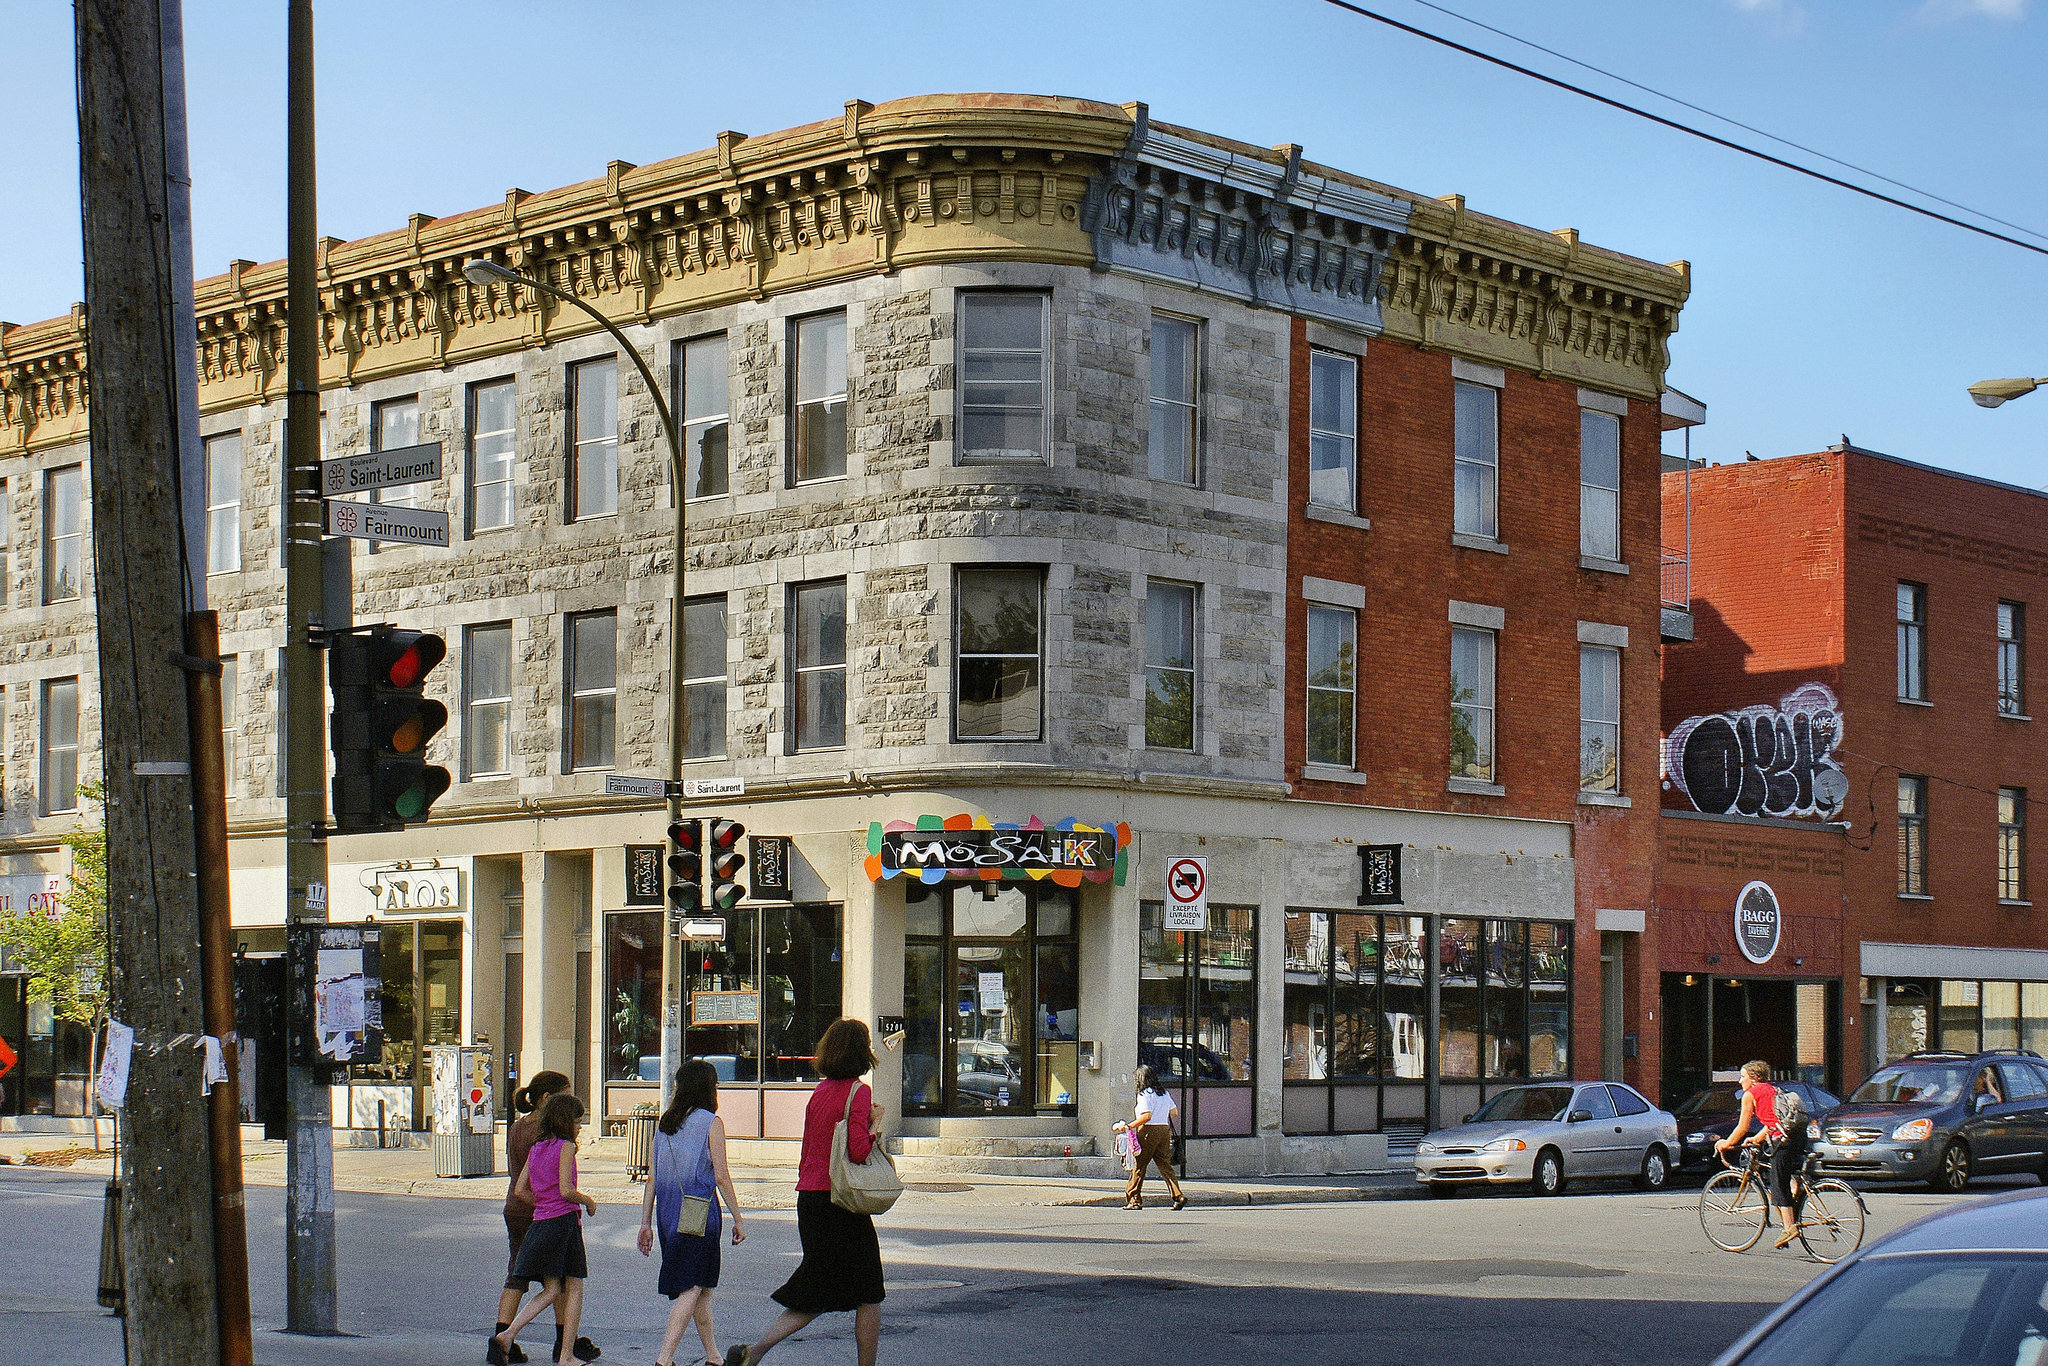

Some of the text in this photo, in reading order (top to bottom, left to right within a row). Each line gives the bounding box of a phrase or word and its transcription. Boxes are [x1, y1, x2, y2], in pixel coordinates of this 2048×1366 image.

[350, 459, 434, 487] Saint-Laurent
[365, 507, 389, 516] Avenue
[365, 516, 443, 541] Fairmount
[609, 781, 649, 794] Fairmount
[697, 783, 741, 794] Saint-Laurent
[1169, 911, 1201, 919] LIVRAISON
[1742, 909, 1775, 923] BAGG
[1747, 925, 1770, 936] TAVERNE
[885, 1022, 903, 1031] 5201
